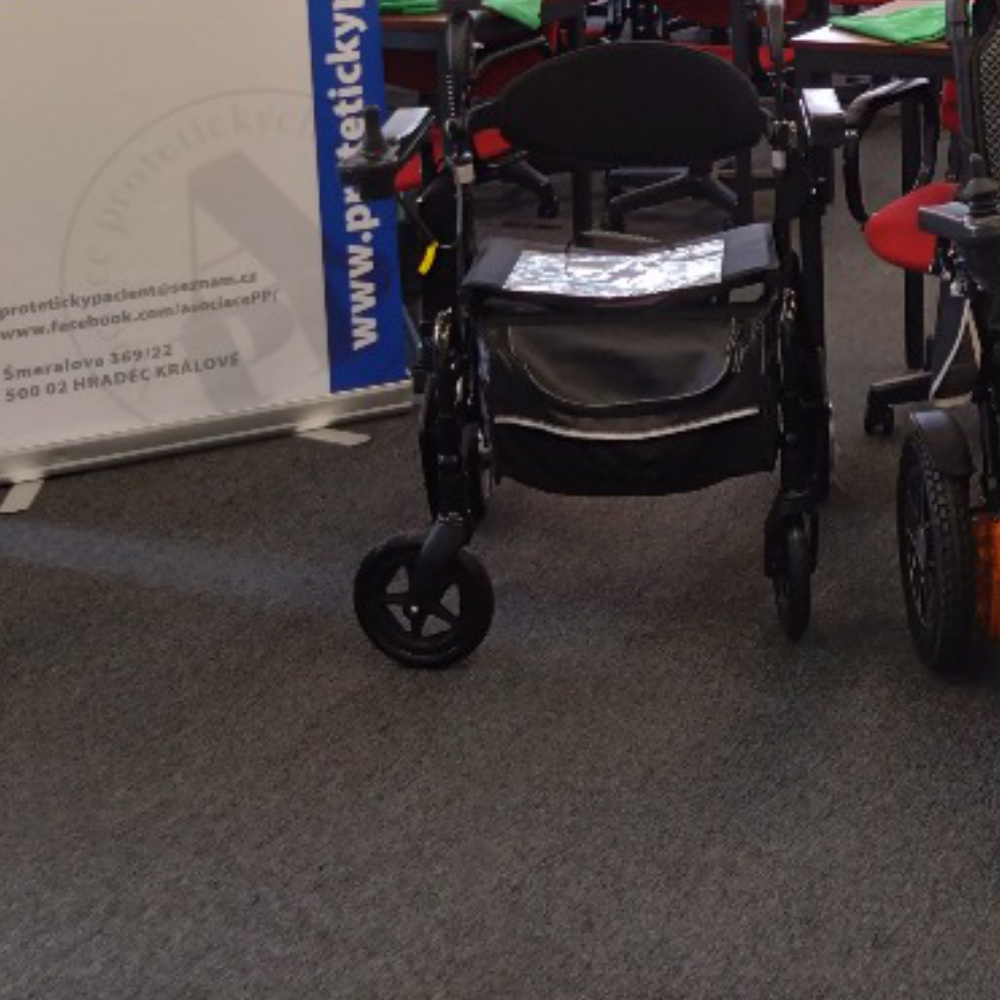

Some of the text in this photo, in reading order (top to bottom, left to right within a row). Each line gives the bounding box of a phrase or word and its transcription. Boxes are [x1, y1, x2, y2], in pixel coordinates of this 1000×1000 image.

[5, 383, 40, 402] 500
[46, 379, 68, 396] 02
[73, 368, 151, 392] HRADEC
